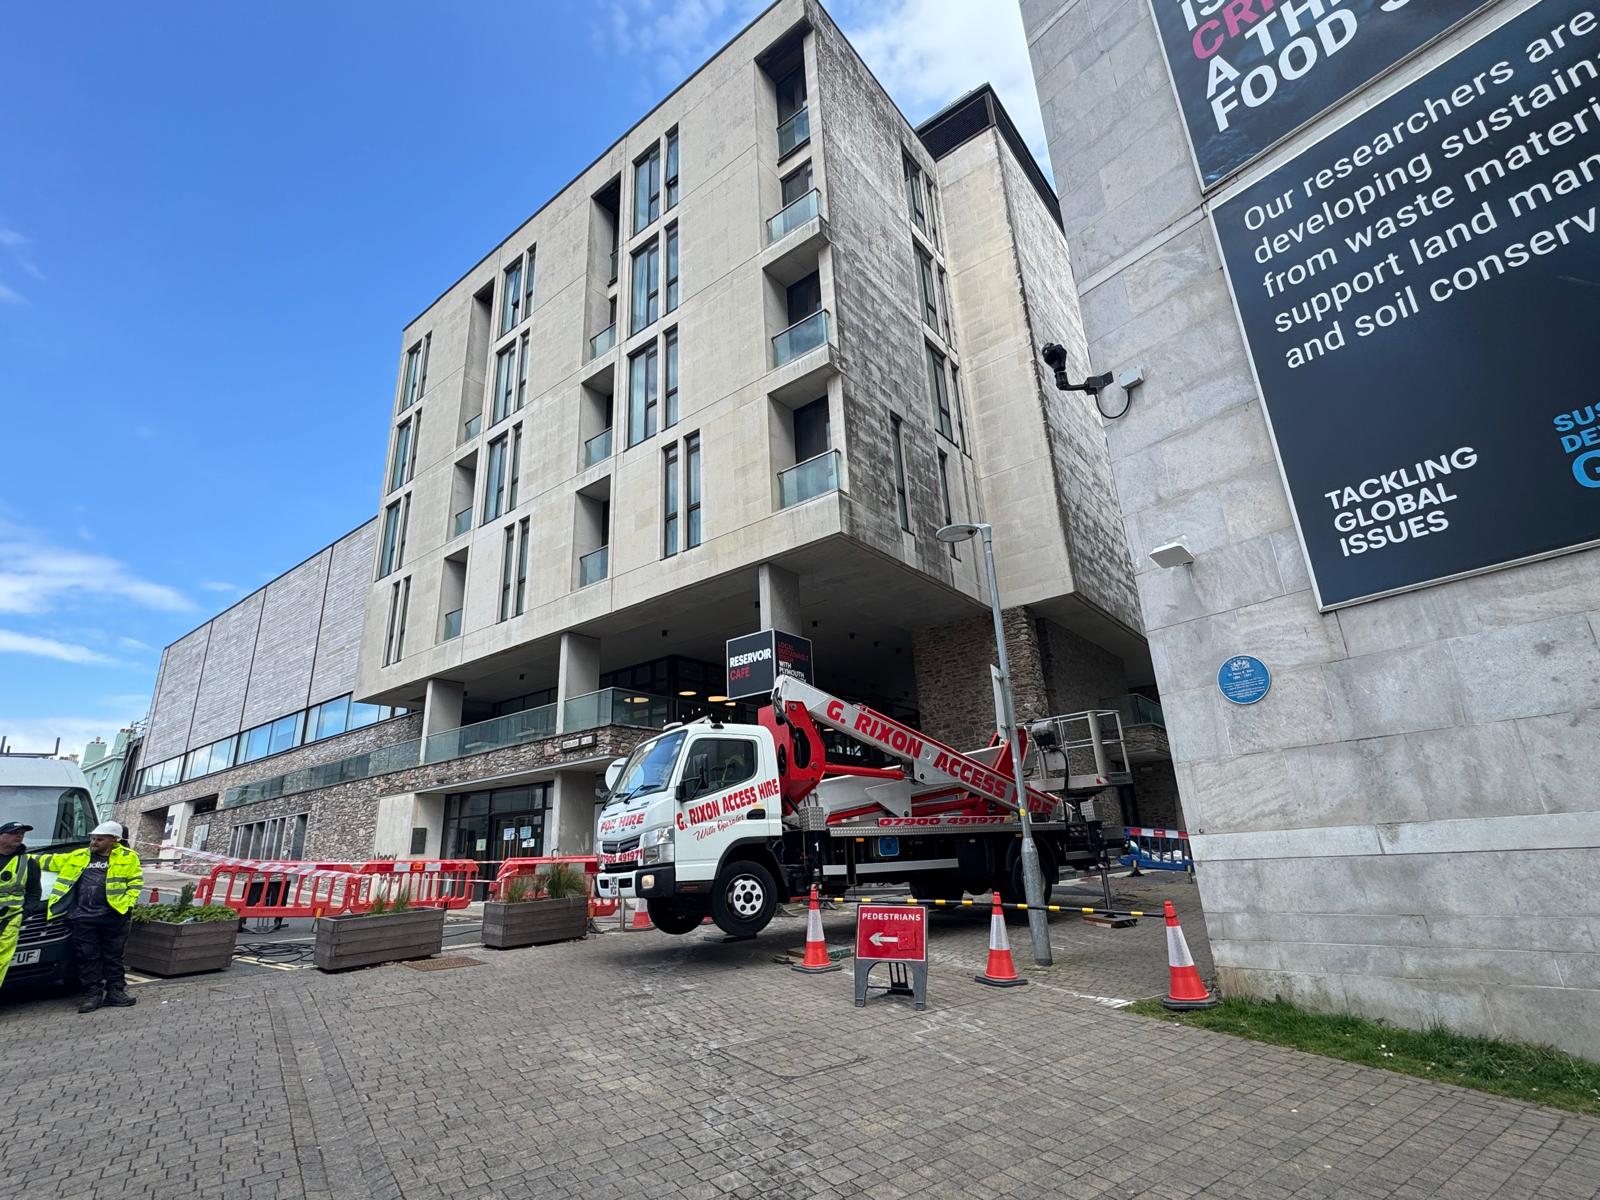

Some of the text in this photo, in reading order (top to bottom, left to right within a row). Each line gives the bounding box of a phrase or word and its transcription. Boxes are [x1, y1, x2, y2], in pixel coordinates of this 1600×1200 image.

[1206, 0, 1343, 99] A TH
[1210, 8, 1358, 132] FOOD
[1244, 11, 1599, 232] Our researchers are
[1254, 51, 1600, 264] developing sustain
[1262, 247, 1338, 299] from
[1344, 185, 1456, 254] waste
[1274, 252, 1404, 333] support
[1410, 201, 1498, 265] land
[1286, 206, 1597, 369] and soil conserv
[1553, 402, 1600, 432] SU
[1560, 425, 1600, 454] DE
[1324, 446, 1478, 510] TACKLING
[1334, 482, 1458, 533] GLOBAL
[1339, 510, 1450, 557] ISSUES
[729, 648, 772, 668] RESERVOIR
[779, 660, 792, 669] WITH
[779, 667, 805, 679] PLYMOUTH
[827, 700, 846, 725] G.
[854, 714, 923, 759] RIXON
[933, 754, 1007, 798] ACCESS
[619, 812, 645, 828] HIRE
[676, 778, 780, 831] G. RIXON ACCESS HIRE
[879, 815, 1005, 827] 07900 491971
[618, 848, 644, 863] 491971
[693, 825, 716, 841] With
[862, 912, 921, 922] PEDESTRIANS
